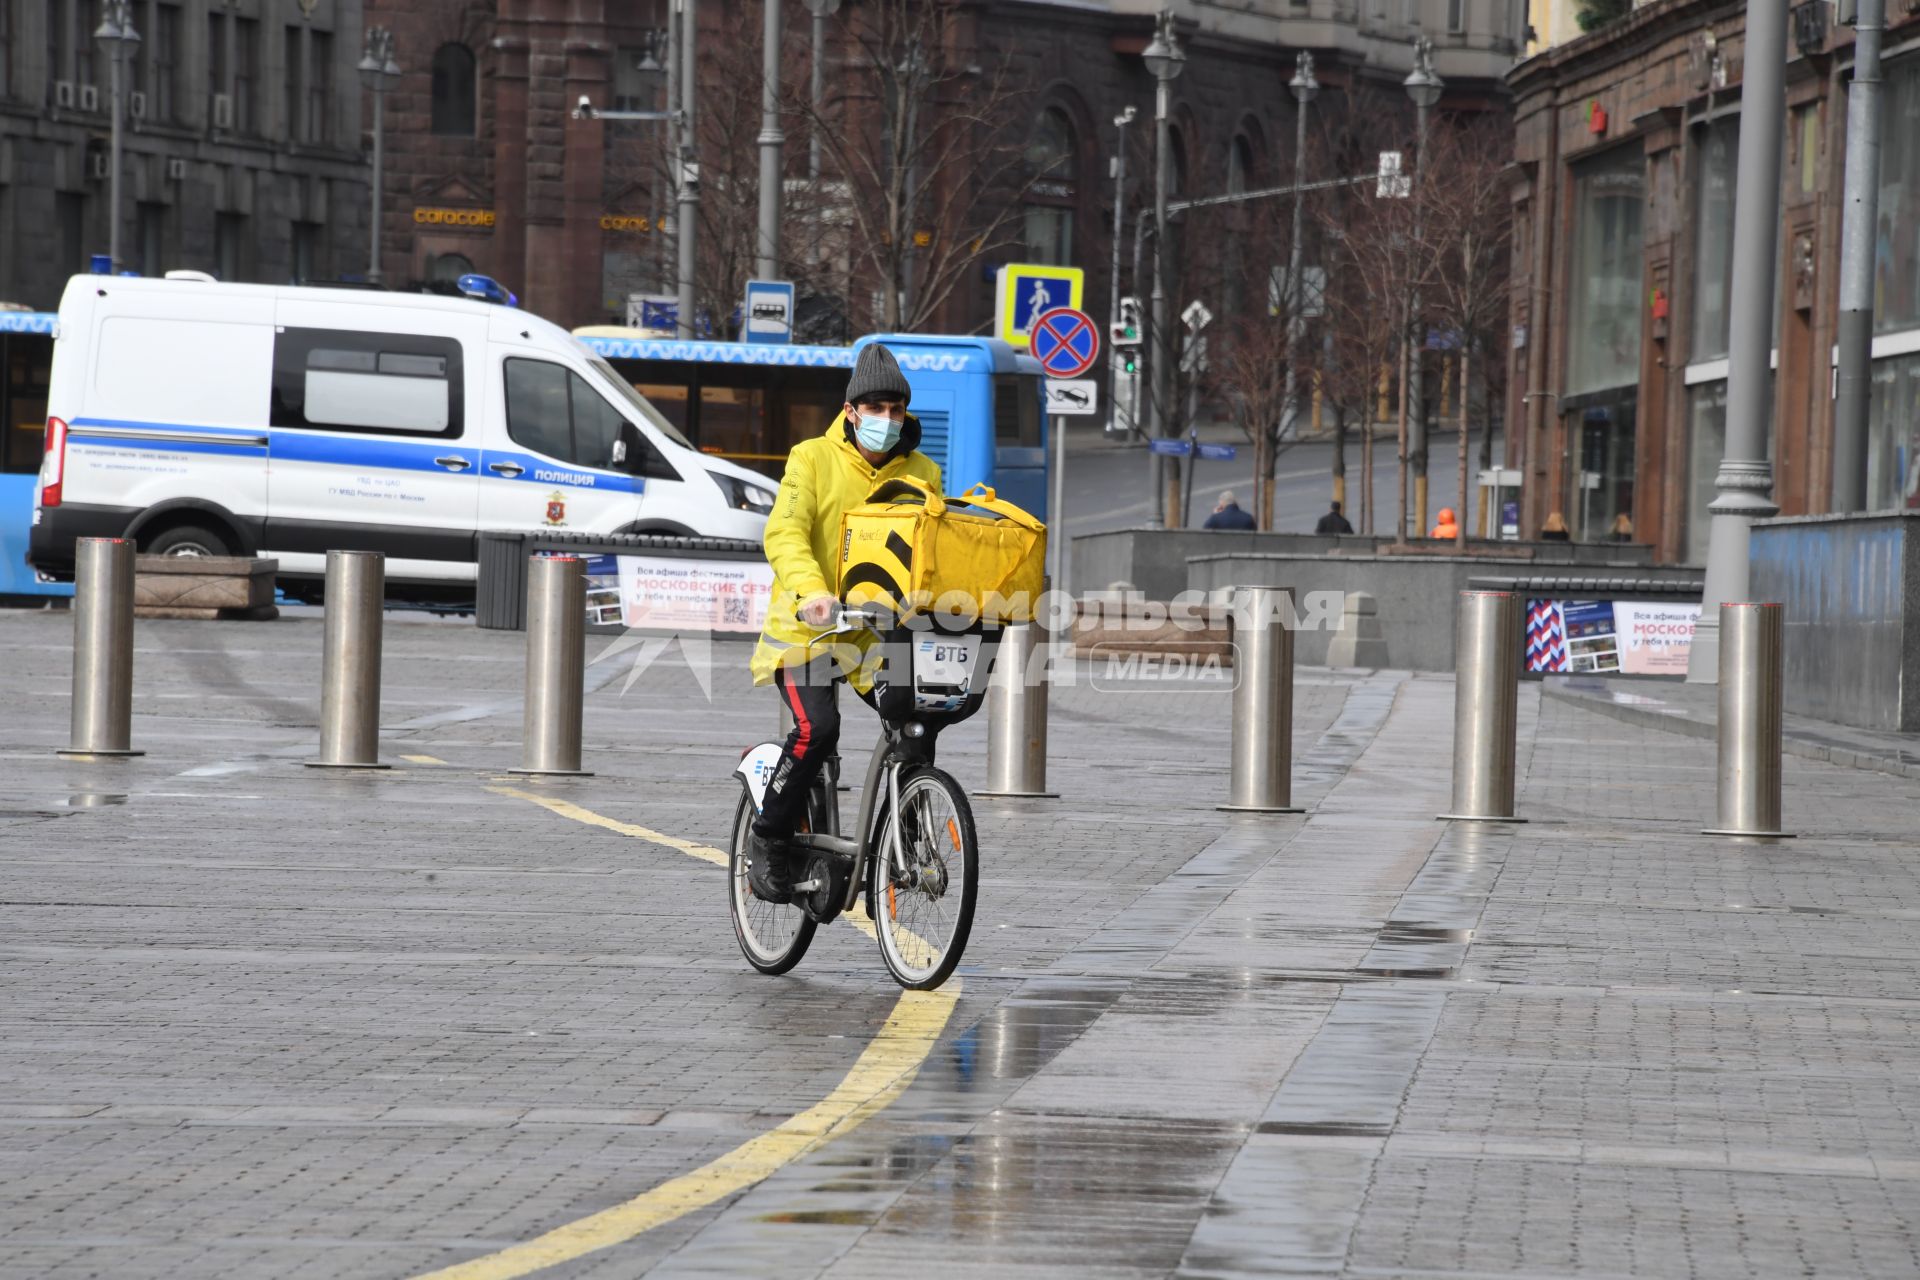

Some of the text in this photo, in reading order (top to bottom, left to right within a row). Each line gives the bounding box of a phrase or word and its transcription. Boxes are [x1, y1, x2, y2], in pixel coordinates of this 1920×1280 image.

[413, 207, 495, 226] caracole
[535, 470, 595, 485] ПОЛИЦИЯ
[339, 488, 355, 496] МВД
[637, 567, 745, 580] Вся афиша фестивалей
[637, 579, 773, 595] МОСКОВСКИЕ СЕЗ
[1634, 612, 1651, 620] Вся
[1654, 612, 1687, 622] афиша
[1634, 624, 1696, 635] МОСКОВ
[1641, 638, 1662, 646] тебя
[935, 645, 967, 662] ВТБ
[762, 766, 776, 786] ВТ
